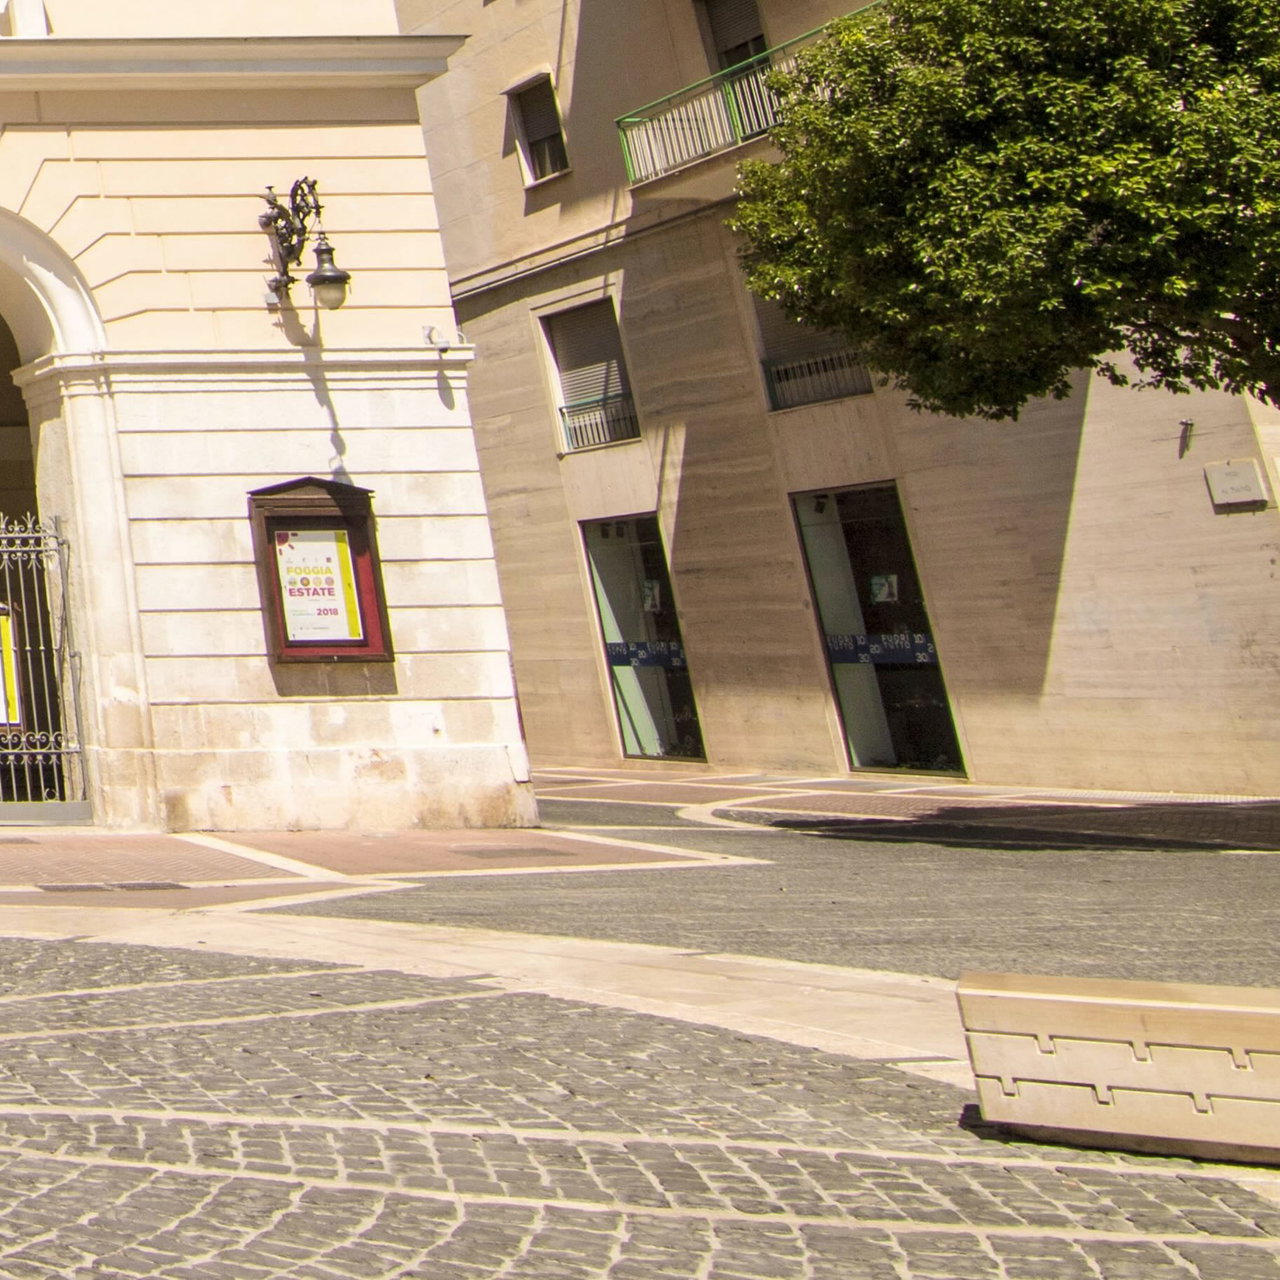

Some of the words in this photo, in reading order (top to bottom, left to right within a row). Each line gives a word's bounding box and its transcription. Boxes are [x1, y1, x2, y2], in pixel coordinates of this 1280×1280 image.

[286, 566, 333, 575] FOGGIA
[288, 588, 336, 596] ESTATE
[316, 608, 339, 616] 2018
[881, 634, 910, 642] FUORI
